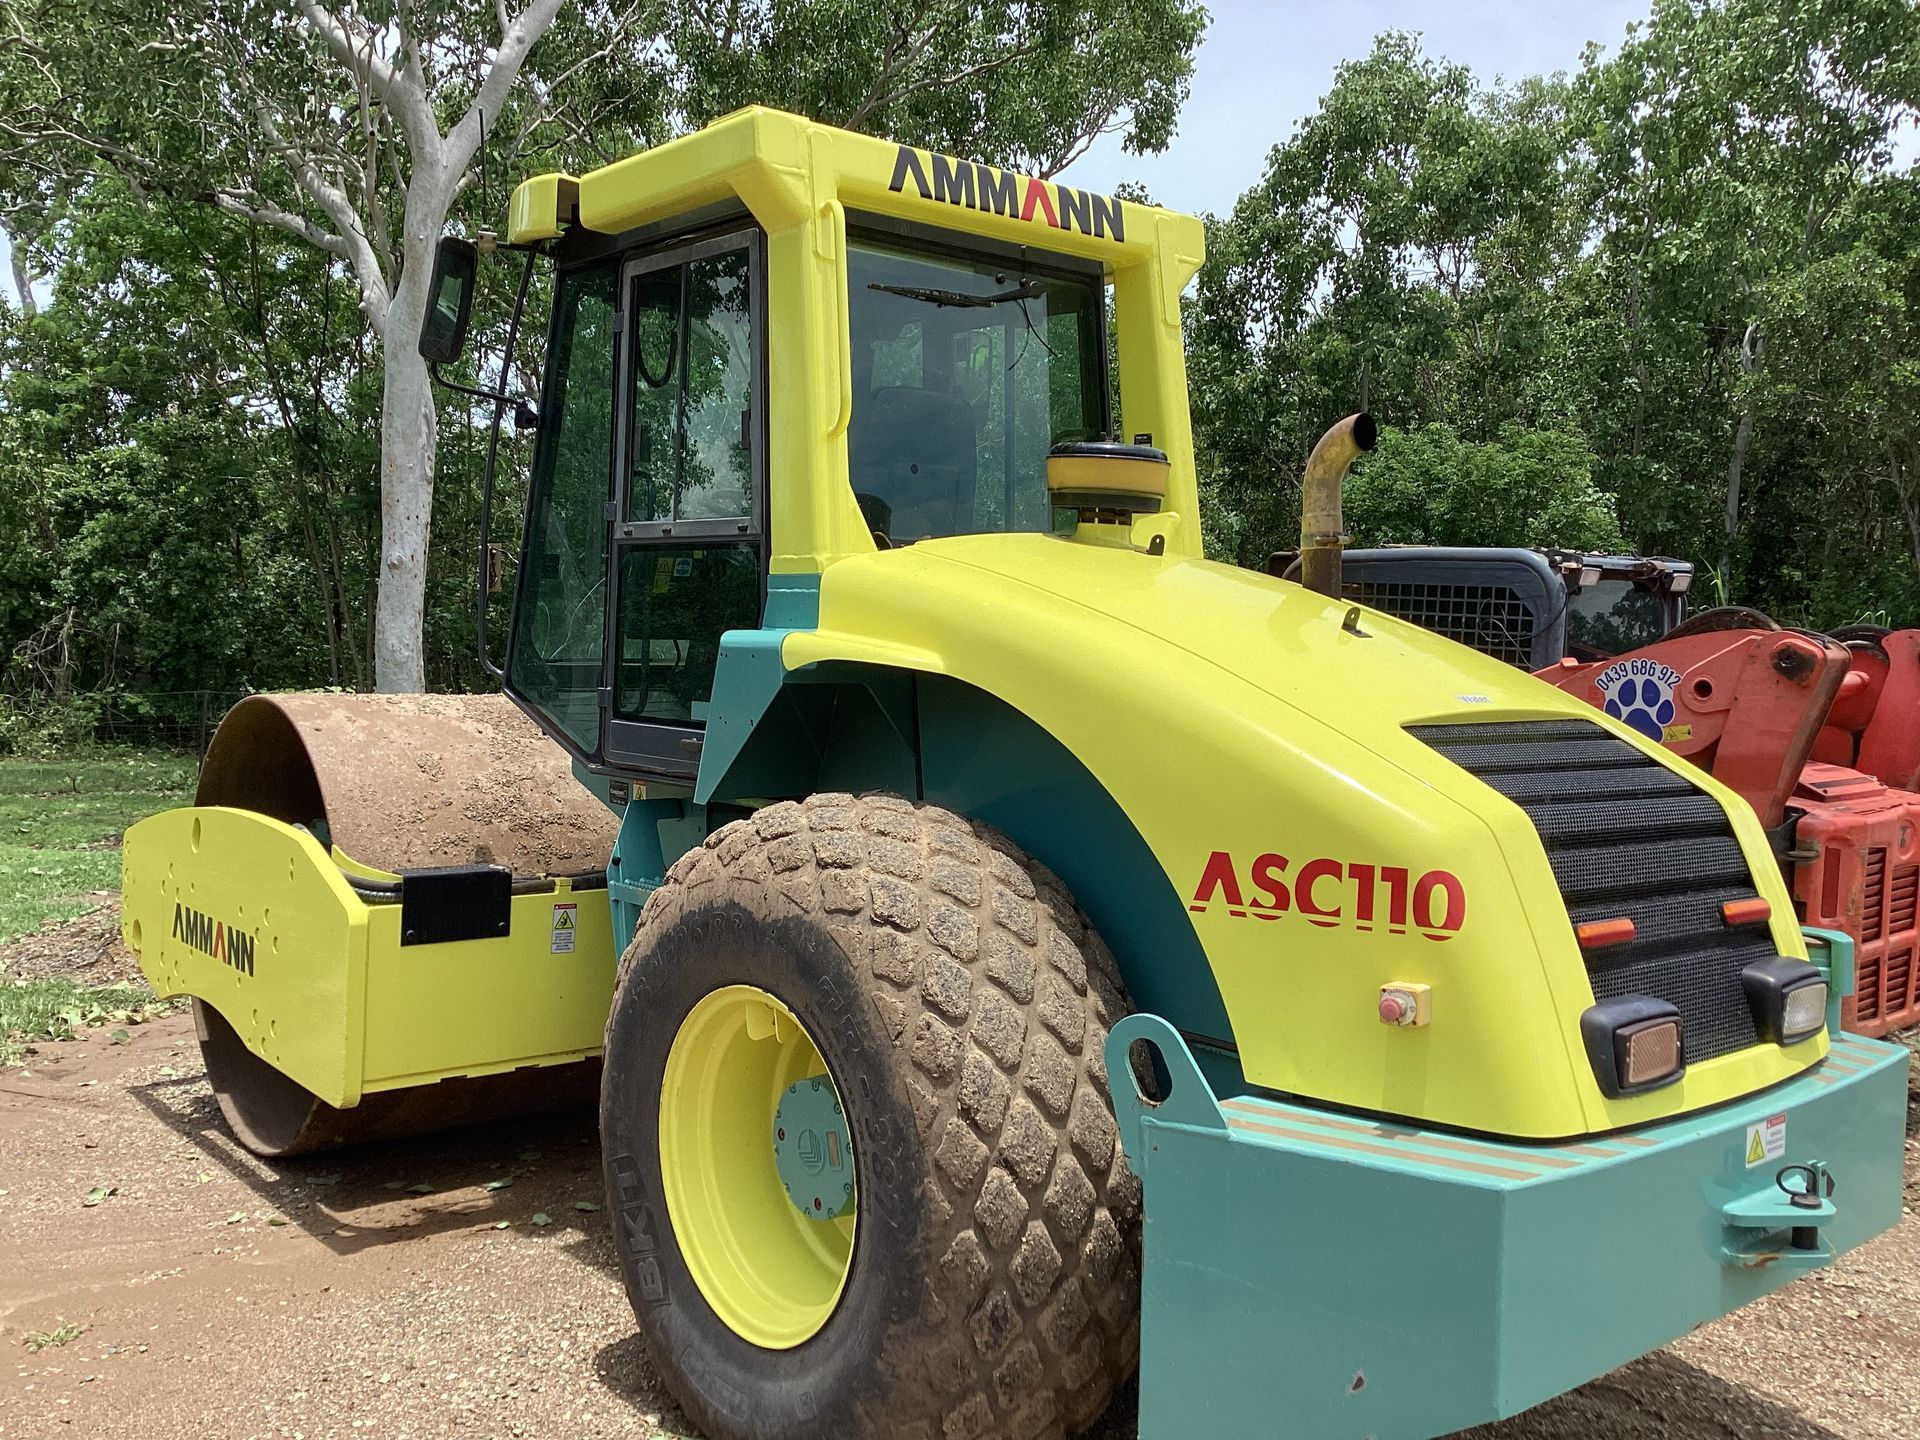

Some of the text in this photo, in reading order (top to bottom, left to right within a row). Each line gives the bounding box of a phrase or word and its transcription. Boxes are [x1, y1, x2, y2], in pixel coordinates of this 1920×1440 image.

[888, 144, 1125, 243] AMMANN
[1596, 659, 1682, 691] 0439 686 912
[172, 902, 255, 978] AMMANN
[1188, 850, 1467, 942] ASC110
[612, 1158, 668, 1302] BKT
